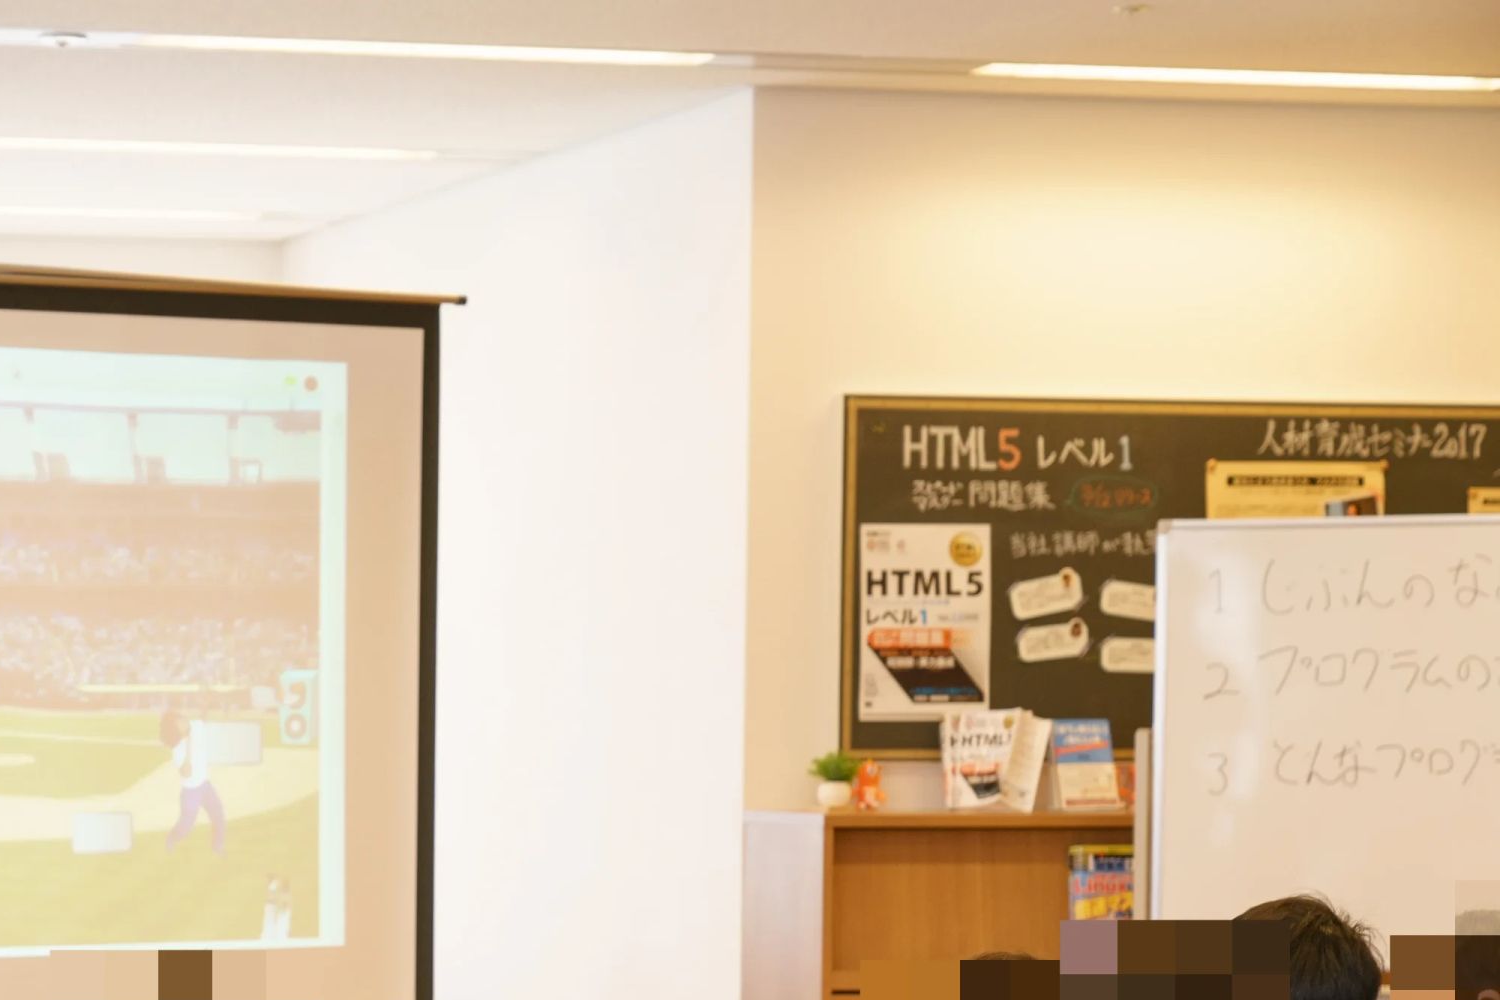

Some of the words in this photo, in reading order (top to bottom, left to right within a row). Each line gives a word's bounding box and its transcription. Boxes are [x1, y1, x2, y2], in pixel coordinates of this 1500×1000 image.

[902, 424, 1022, 471] HTML5
[1036, 434, 1133, 472] レベル1
[866, 569, 984, 597] HTML5
[1208, 567, 1223, 614] 1
[1261, 553, 1500, 615] じぶんのな
[866, 608, 927, 625] レベル1
[1203, 661, 1241, 700] 2
[1257, 645, 1500, 696] プログラムの
[1207, 752, 1229, 797] 3
